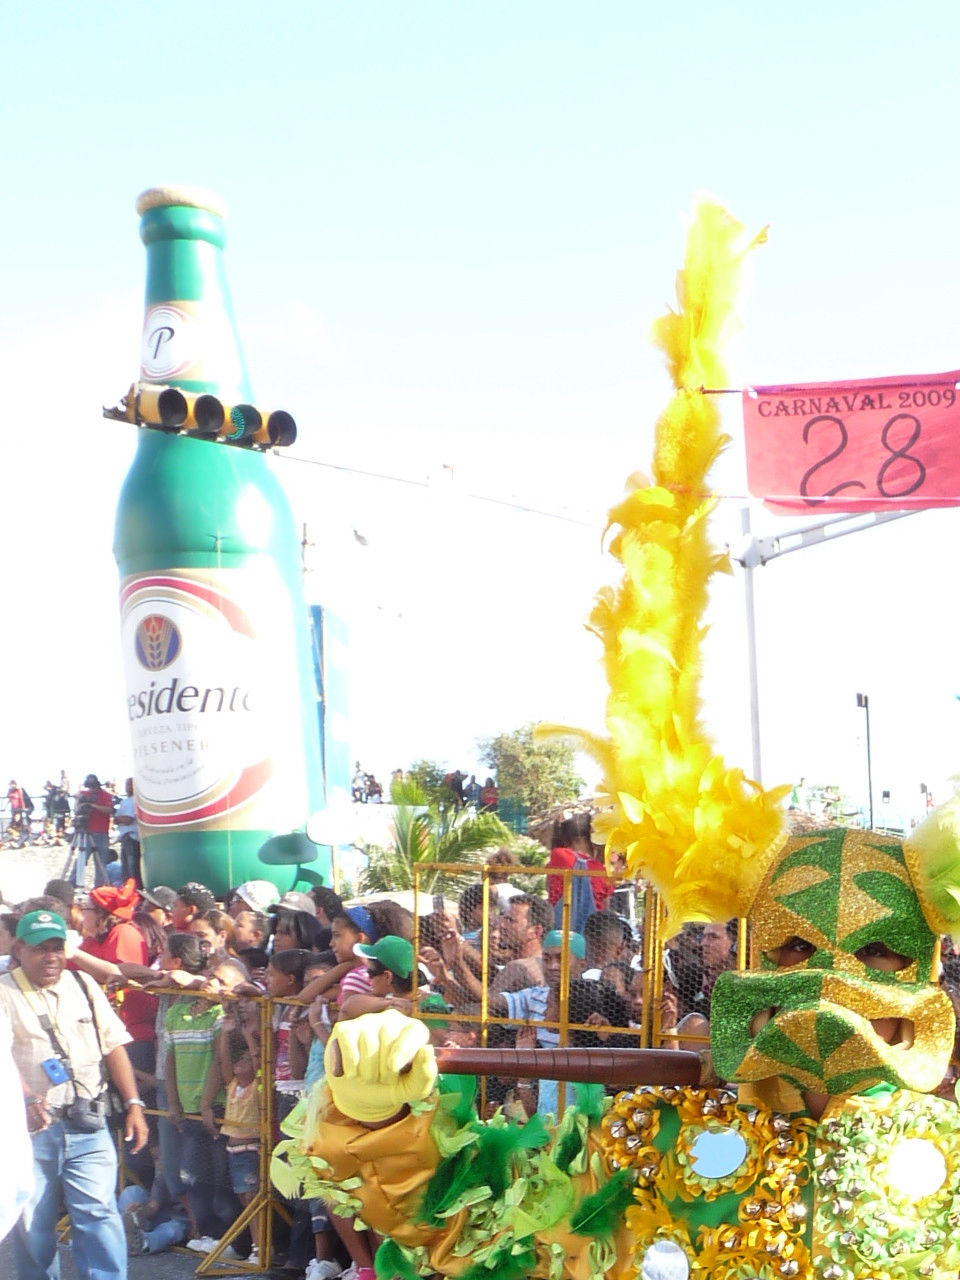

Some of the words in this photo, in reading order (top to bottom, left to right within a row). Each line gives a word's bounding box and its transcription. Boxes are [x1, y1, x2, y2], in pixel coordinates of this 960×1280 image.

[148, 326, 175, 360] P
[757, 391, 893, 418] CARNAVAL
[898, 388, 957, 409] 2009
[800, 413, 926, 507] 28
